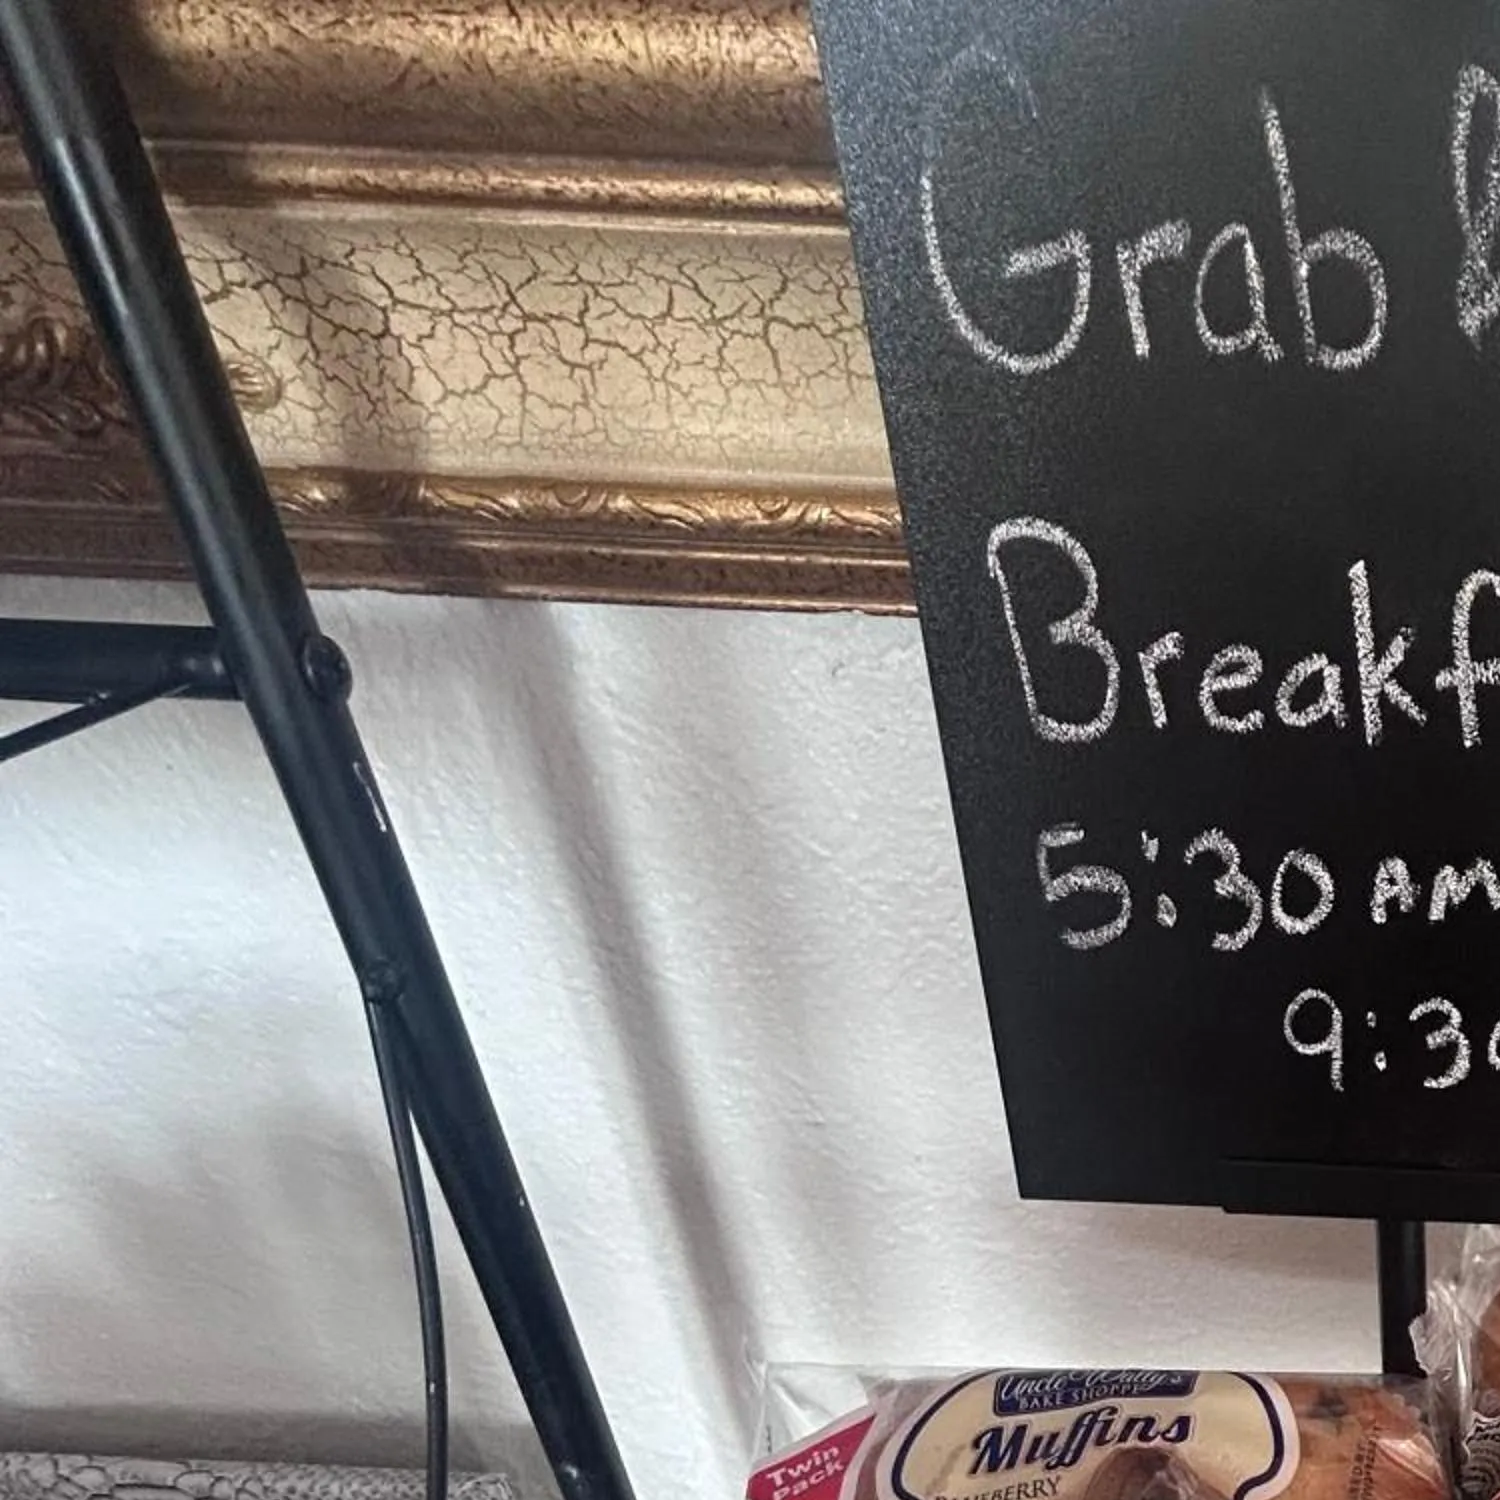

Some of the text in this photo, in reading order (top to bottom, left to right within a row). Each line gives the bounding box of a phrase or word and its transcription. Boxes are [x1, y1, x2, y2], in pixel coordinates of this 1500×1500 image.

[919, 46, 1388, 375] Grab
[1036, 823, 1337, 951] 5:30
[766, 1446, 840, 1488] Twin
[968, 1406, 1193, 1475] Muffins
